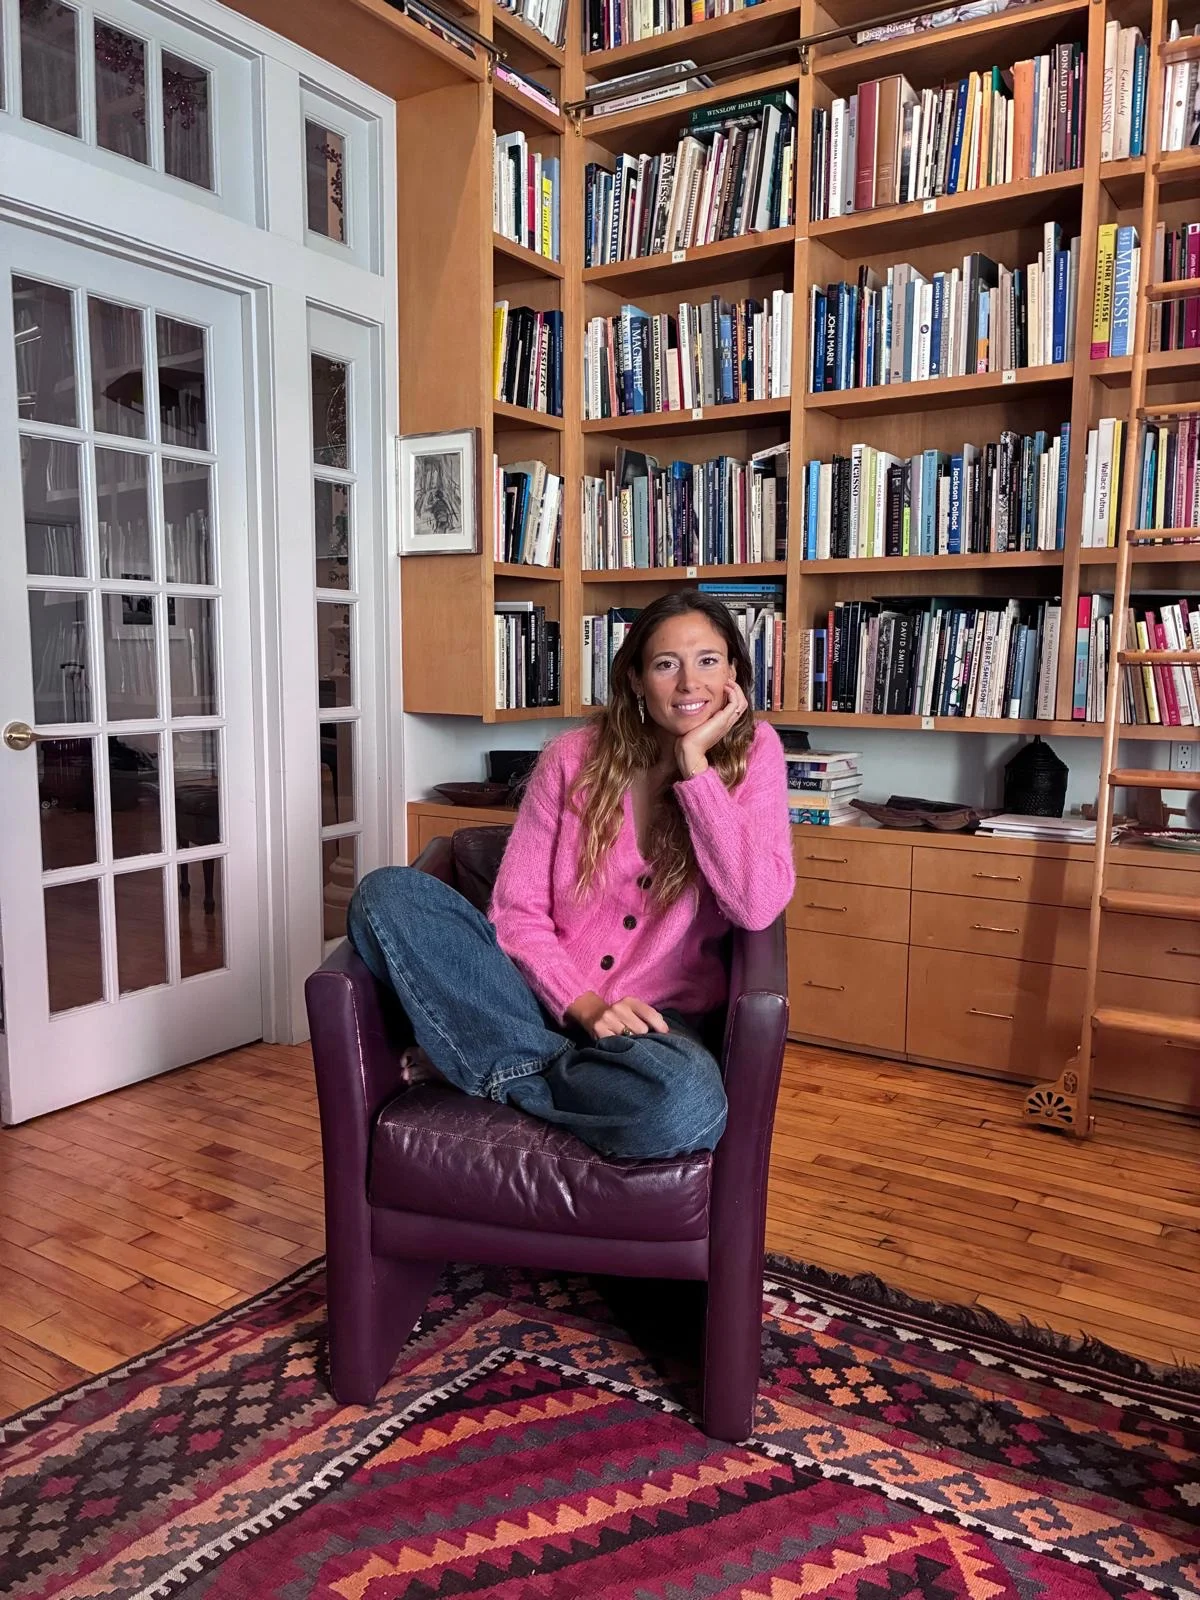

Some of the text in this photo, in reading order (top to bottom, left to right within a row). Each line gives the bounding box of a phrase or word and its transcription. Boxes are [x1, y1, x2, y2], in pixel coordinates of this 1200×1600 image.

[862, 28, 887, 40] Diego
[1061, 50, 1069, 87] DONALD
[1118, 68, 1128, 117] Kandinsky
[707, 99, 762, 117] WINSLOW HOMER
[1103, 67, 1113, 134] KANDINSKY
[657, 155, 673, 208] EVA HESSE
[611, 195, 620, 264] HEARTFIELD
[1102, 253, 1113, 324] HENRI MATISSE
[1114, 250, 1131, 329] MATISSE
[543, 322, 548, 336] EL
[623, 314, 632, 369] MAGRITTE
[826, 312, 837, 367] JOHN MARIN
[632, 327, 643, 390] MAGRITTE
[852, 455, 862, 497] Picasso
[1058, 434, 1069, 494] PRENDERGAST
[1098, 462, 1109, 519] Wallace Putnam
[951, 467, 961, 531] Jackson Pollock
[834, 627, 842, 643] JOHN
[898, 621, 908, 675] DAVID SMITH
[980, 636, 993, 703] ROBERT SMITHSON
